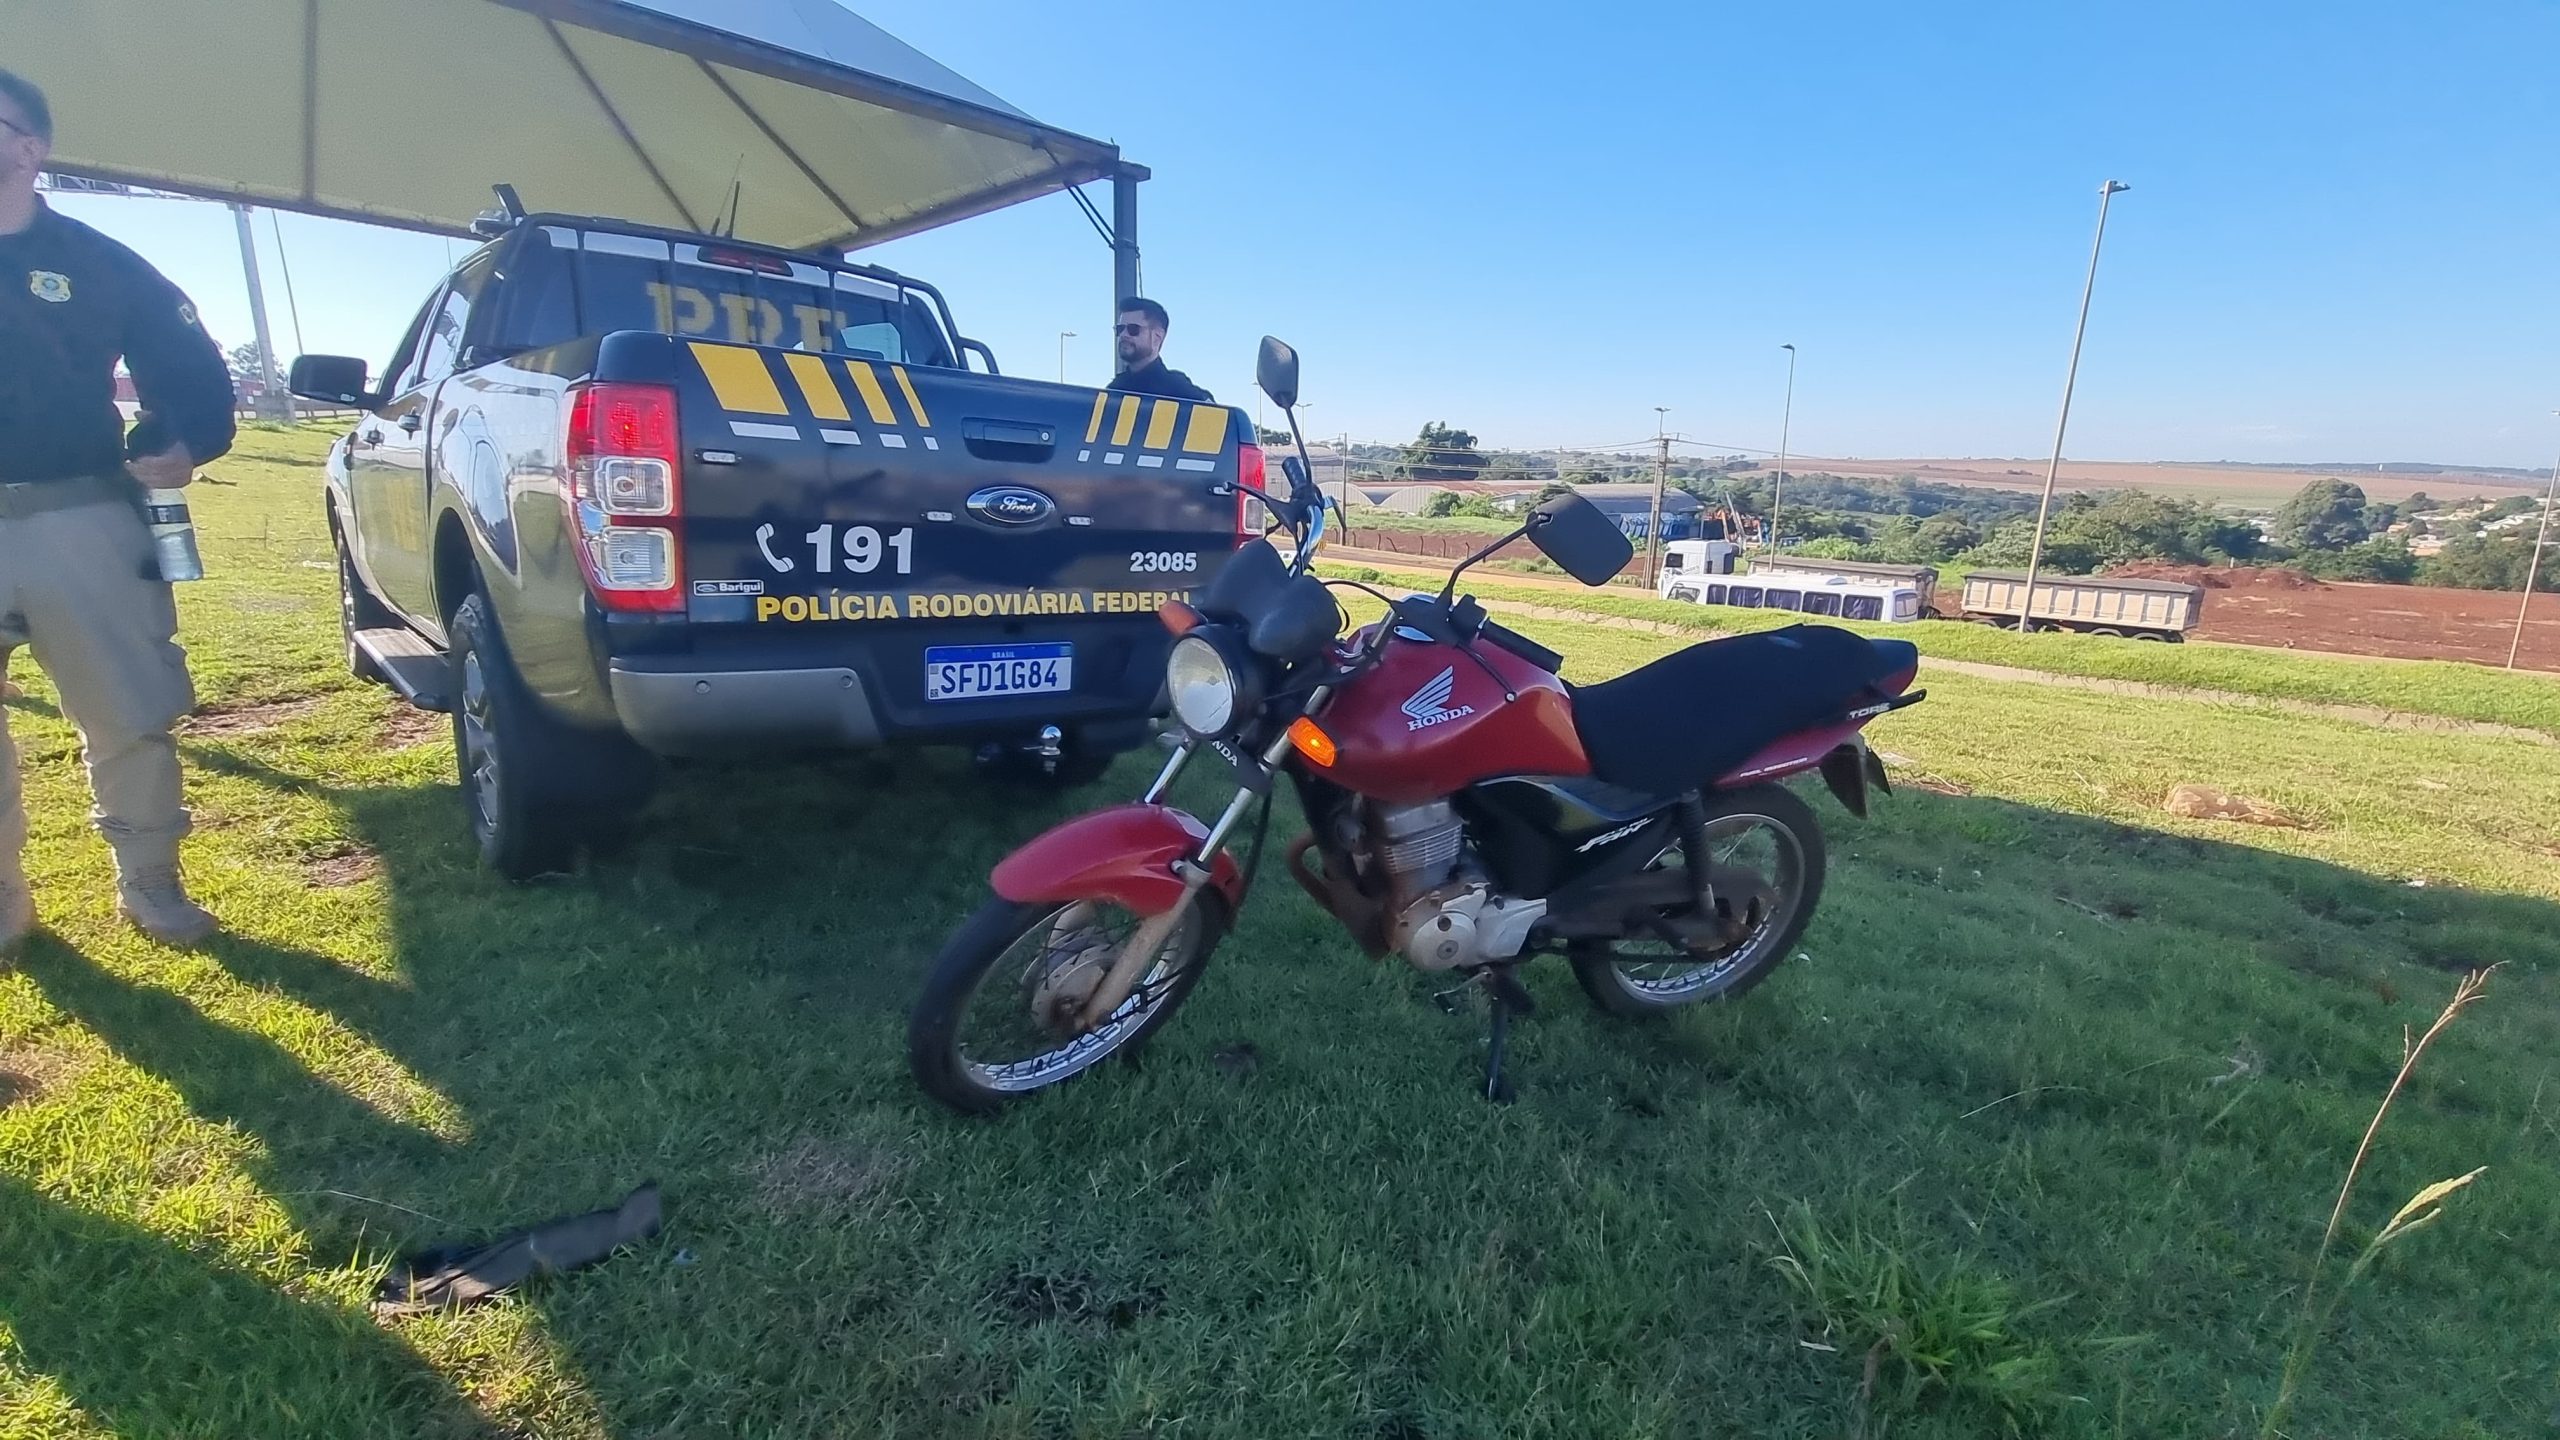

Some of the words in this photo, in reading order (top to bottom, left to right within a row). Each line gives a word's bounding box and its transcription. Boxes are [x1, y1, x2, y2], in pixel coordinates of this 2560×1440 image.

[1000, 496, 1036, 513] Ford
[806, 523, 913, 574] 191
[1129, 551, 1197, 572] 23085
[719, 582, 761, 593] Barigui
[757, 588, 899, 622] POLÍCIA
[908, 586, 1085, 618] RODOVIÁRIA
[992, 650, 1015, 659] BRASIL
[940, 659, 1058, 694] SFD1G84
[1407, 705, 1475, 731] HONDA
[1211, 740, 1238, 767] NDA
